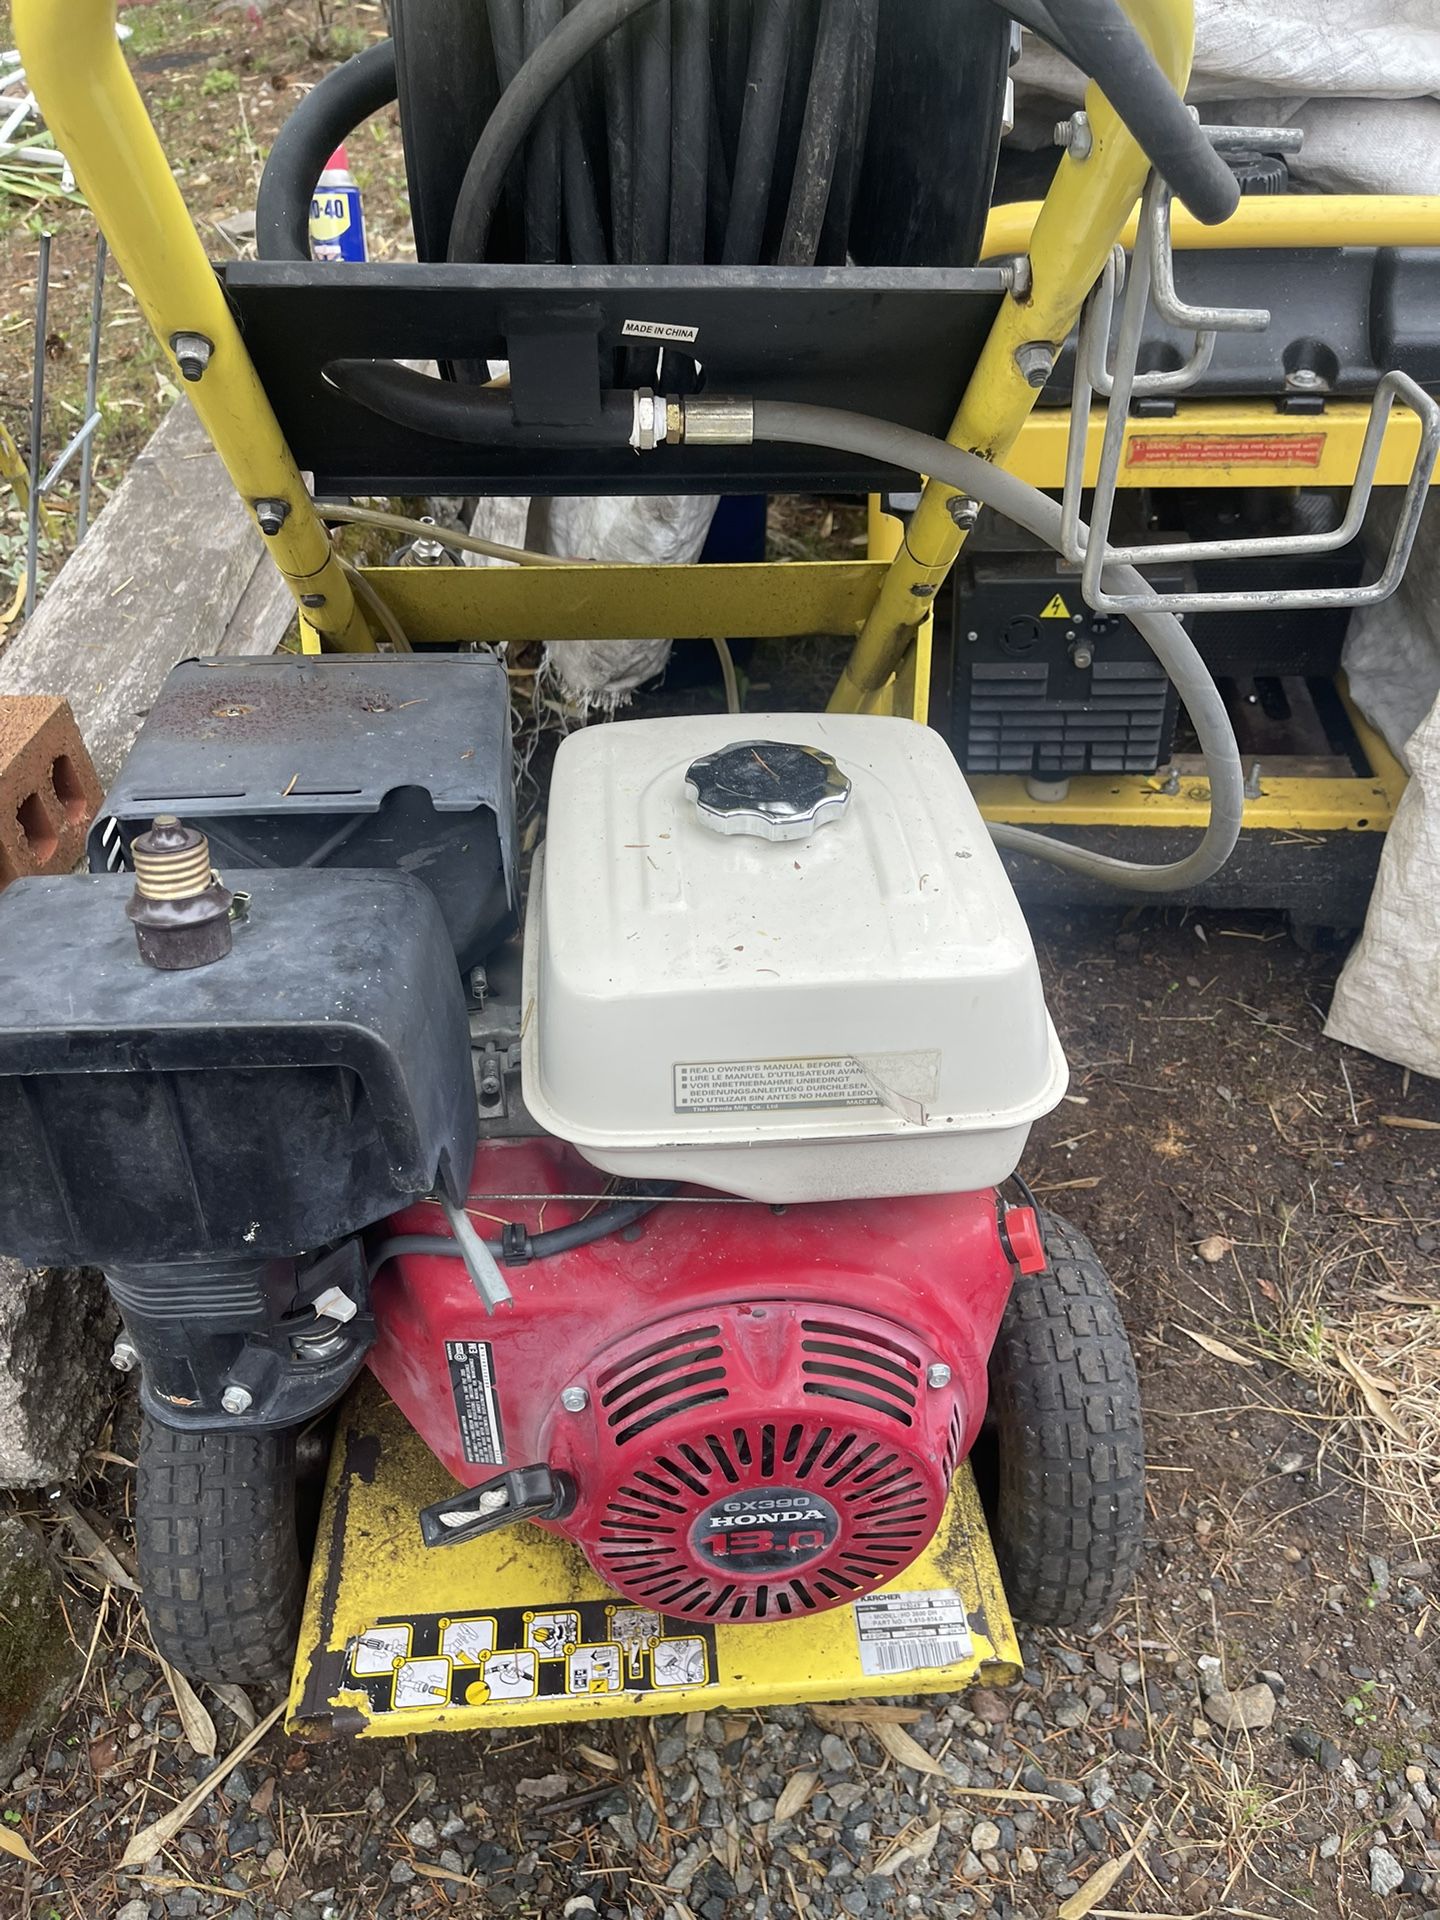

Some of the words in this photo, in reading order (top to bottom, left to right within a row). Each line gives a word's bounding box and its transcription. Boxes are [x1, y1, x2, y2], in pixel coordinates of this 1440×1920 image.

[625, 323, 653, 334] MADE
[654, 326, 665, 335] IN
[665, 327, 694, 338] CHINA
[689, 1066, 715, 1075] READ
[717, 1064, 761, 1073] OWNER'S
[763, 1062, 805, 1071] MANUAL
[806, 1061, 842, 1069] BEFORE
[689, 1074, 710, 1082] LIRE
[724, 1072, 766, 1080] MANUEL
[767, 1068, 836, 1078] D'UTILISATEUR
[689, 1082, 711, 1090] VOR
[711, 1078, 795, 1088] INBETRIEBNAHME
[796, 1075, 850, 1085] UNBEDINGT
[690, 1086, 804, 1097] BEDIENUNGSANLEITUNG
[806, 1082, 870, 1092] DURCHLESEN.
[689, 1097, 705, 1105] NO
[706, 1095, 748, 1104] UTILIZAR
[748, 1094, 765, 1102] SIN
[766, 1093, 797, 1101] ANTES
[799, 1092, 813, 1100] NO
[815, 1091, 846, 1099] HABER
[847, 1089, 873, 1098] LEIDO
[723, 1496, 810, 1513] GX390
[709, 1509, 827, 1527] HONDA
[701, 1529, 826, 1557] 13.0
